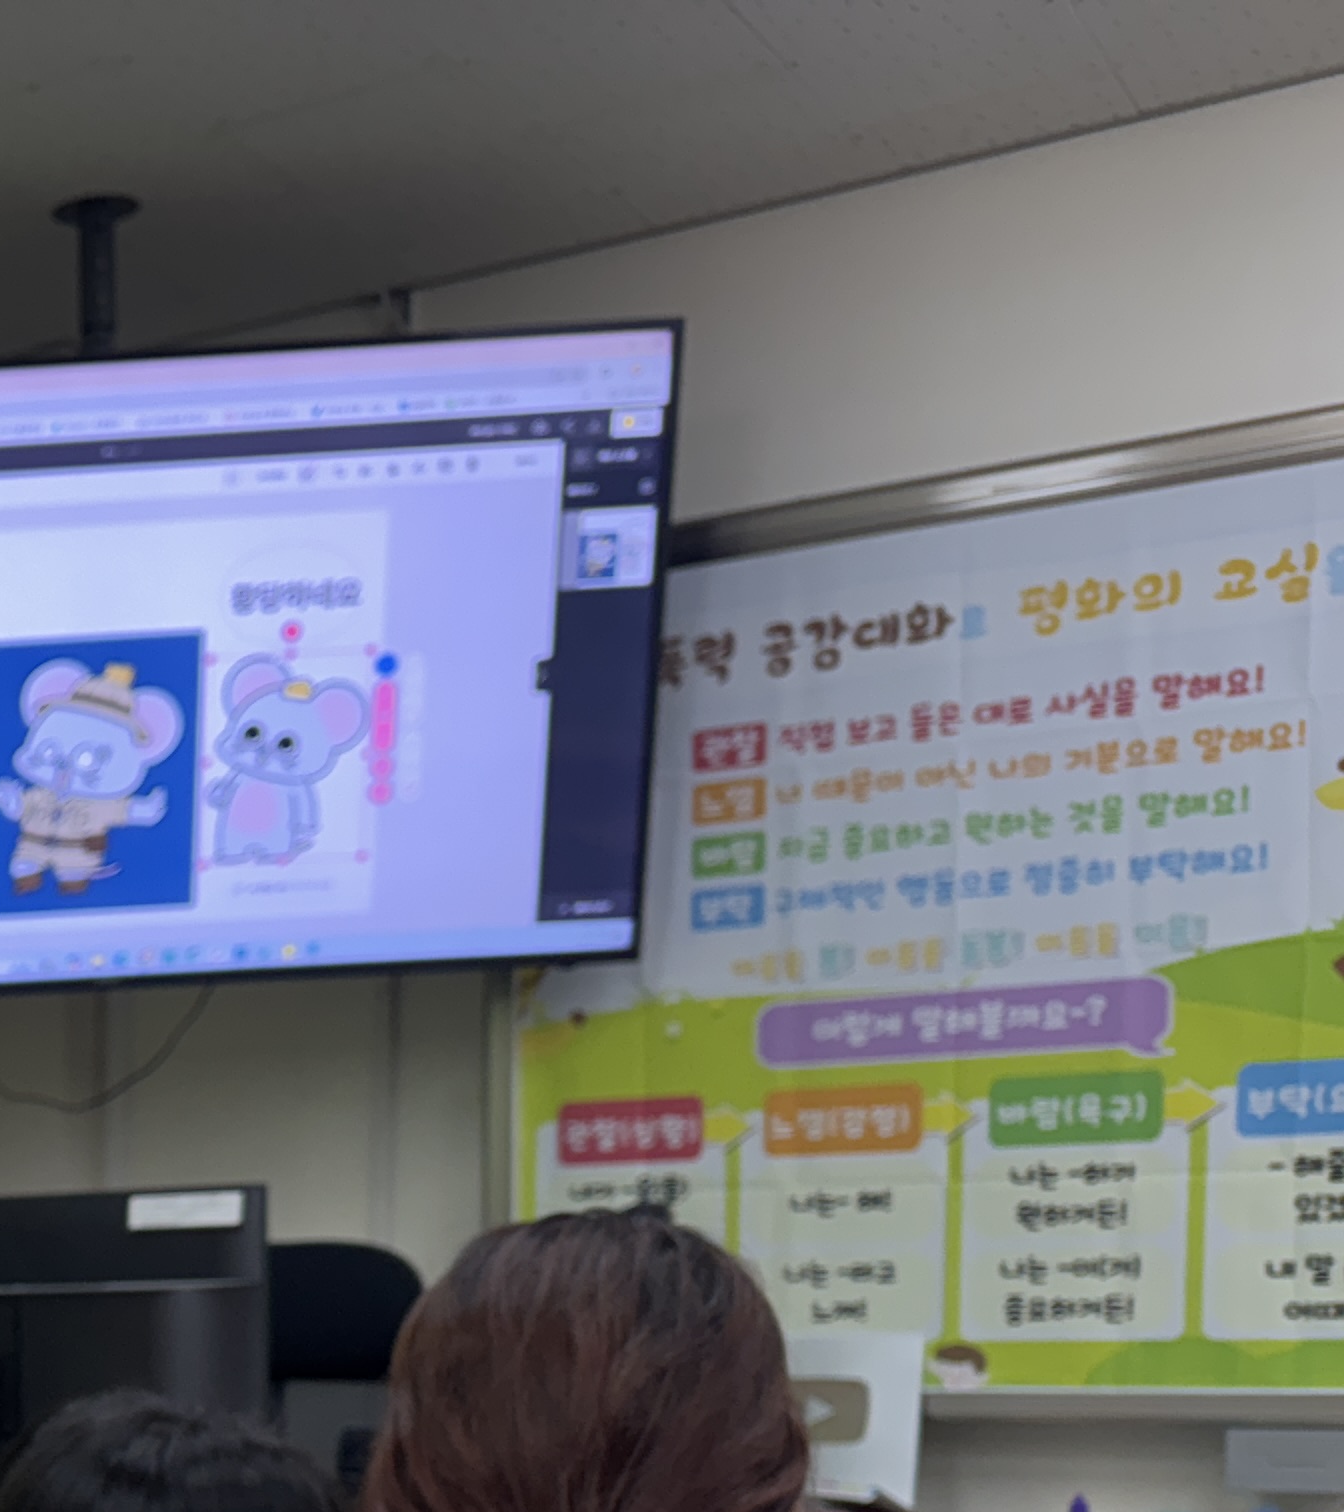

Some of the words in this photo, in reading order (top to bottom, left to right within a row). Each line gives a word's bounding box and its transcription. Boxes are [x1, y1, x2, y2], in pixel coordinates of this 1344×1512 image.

[1018, 569, 1182, 636] 평화의
[846, 713, 897, 746] 보고
[1045, 676, 1136, 719] 사실을
[1152, 663, 1265, 710] 말해요!
[1192, 719, 1306, 764] 말해요!
[1138, 784, 1250, 828] 말해요!
[1128, 841, 1268, 884] 부탁해요!
